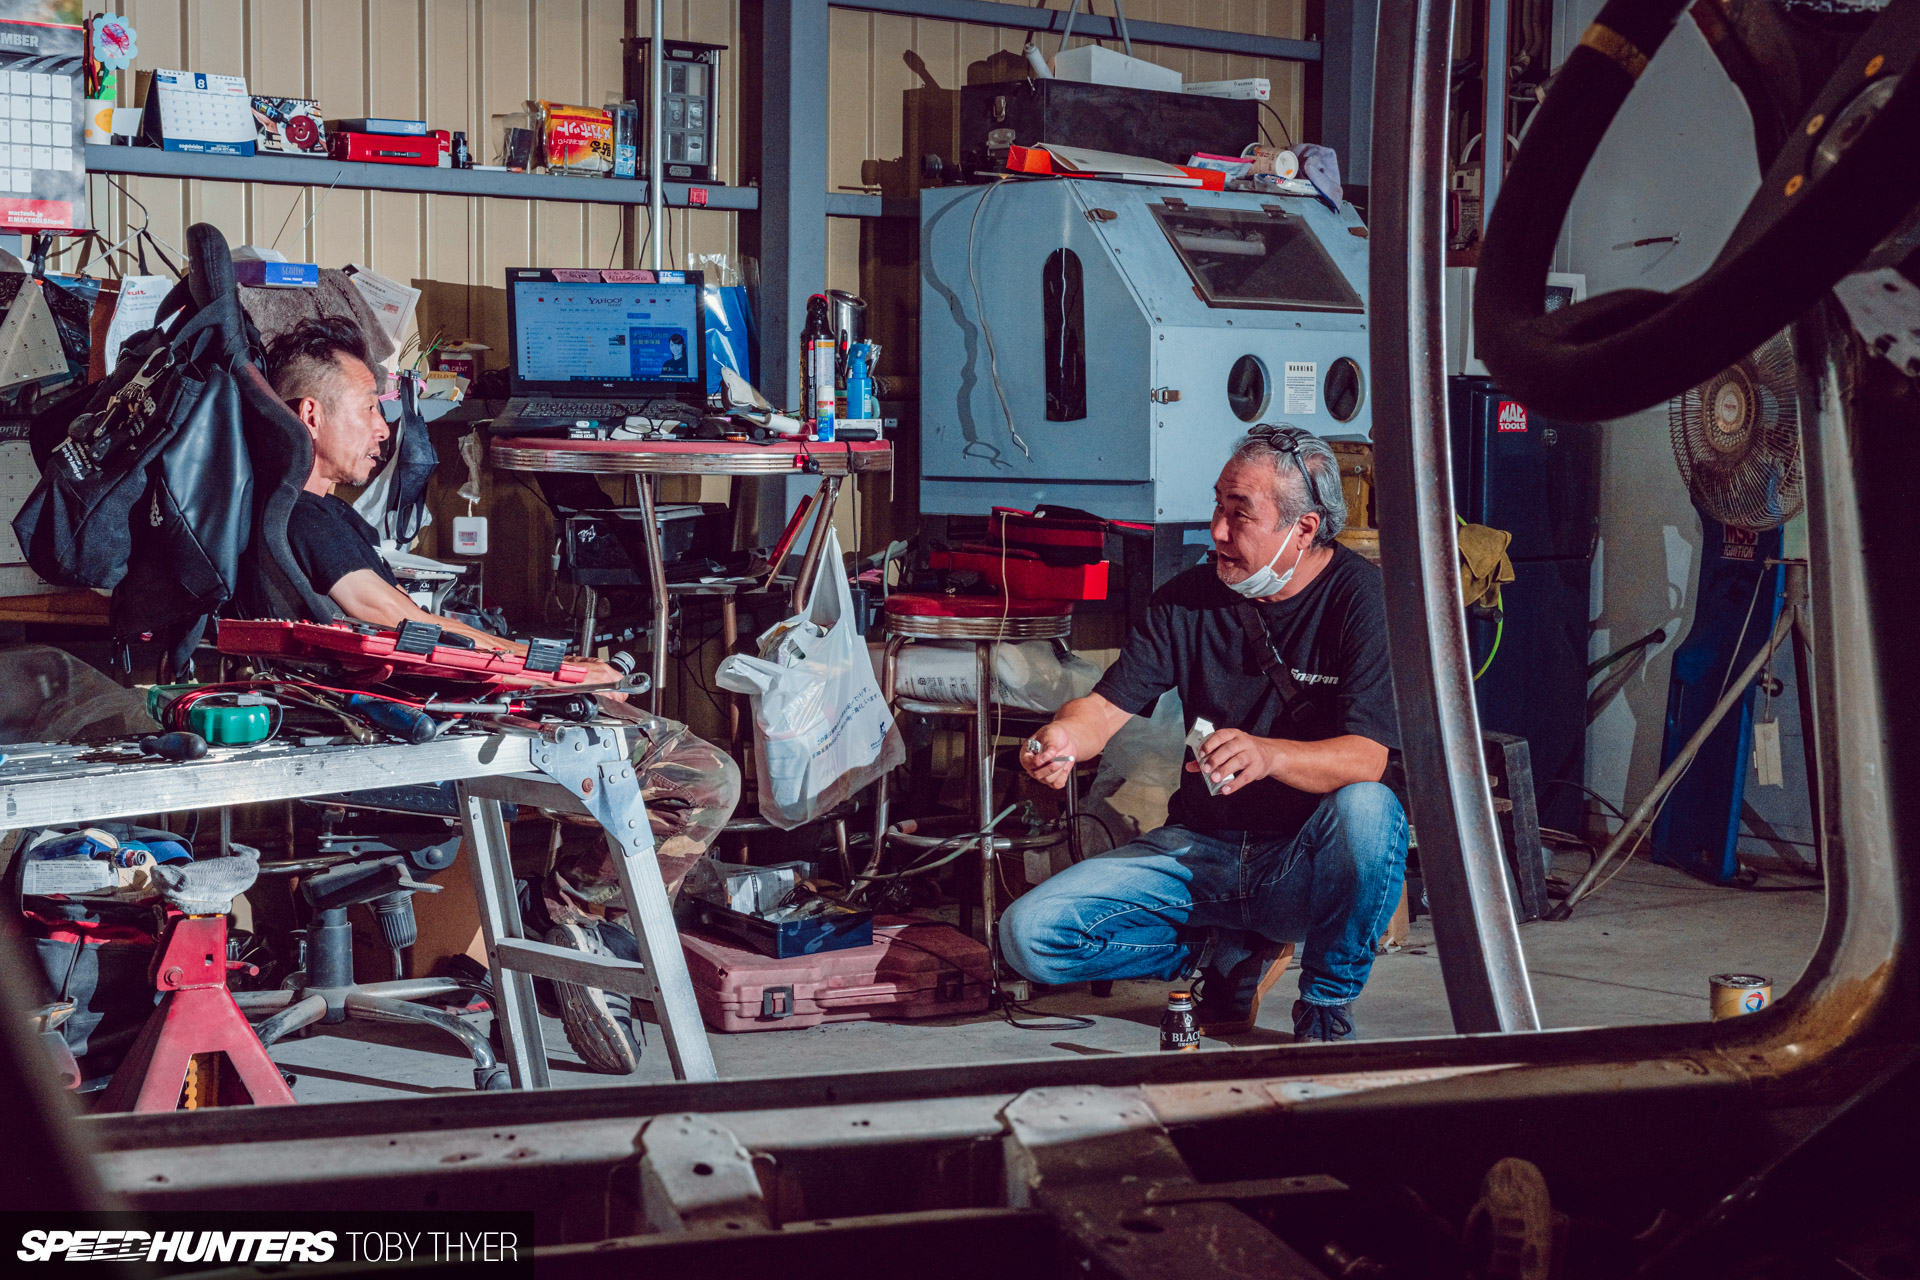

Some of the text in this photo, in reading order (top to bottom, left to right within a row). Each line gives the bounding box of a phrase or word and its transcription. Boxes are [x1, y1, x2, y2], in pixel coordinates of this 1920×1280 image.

[197, 79, 205, 89] 8
[557, 121, 611, 140] メガホット
[1499, 403, 1526, 422] MAC
[1499, 422, 1526, 430] TOOLS
[1723, 544, 1754, 558] IGNITION
